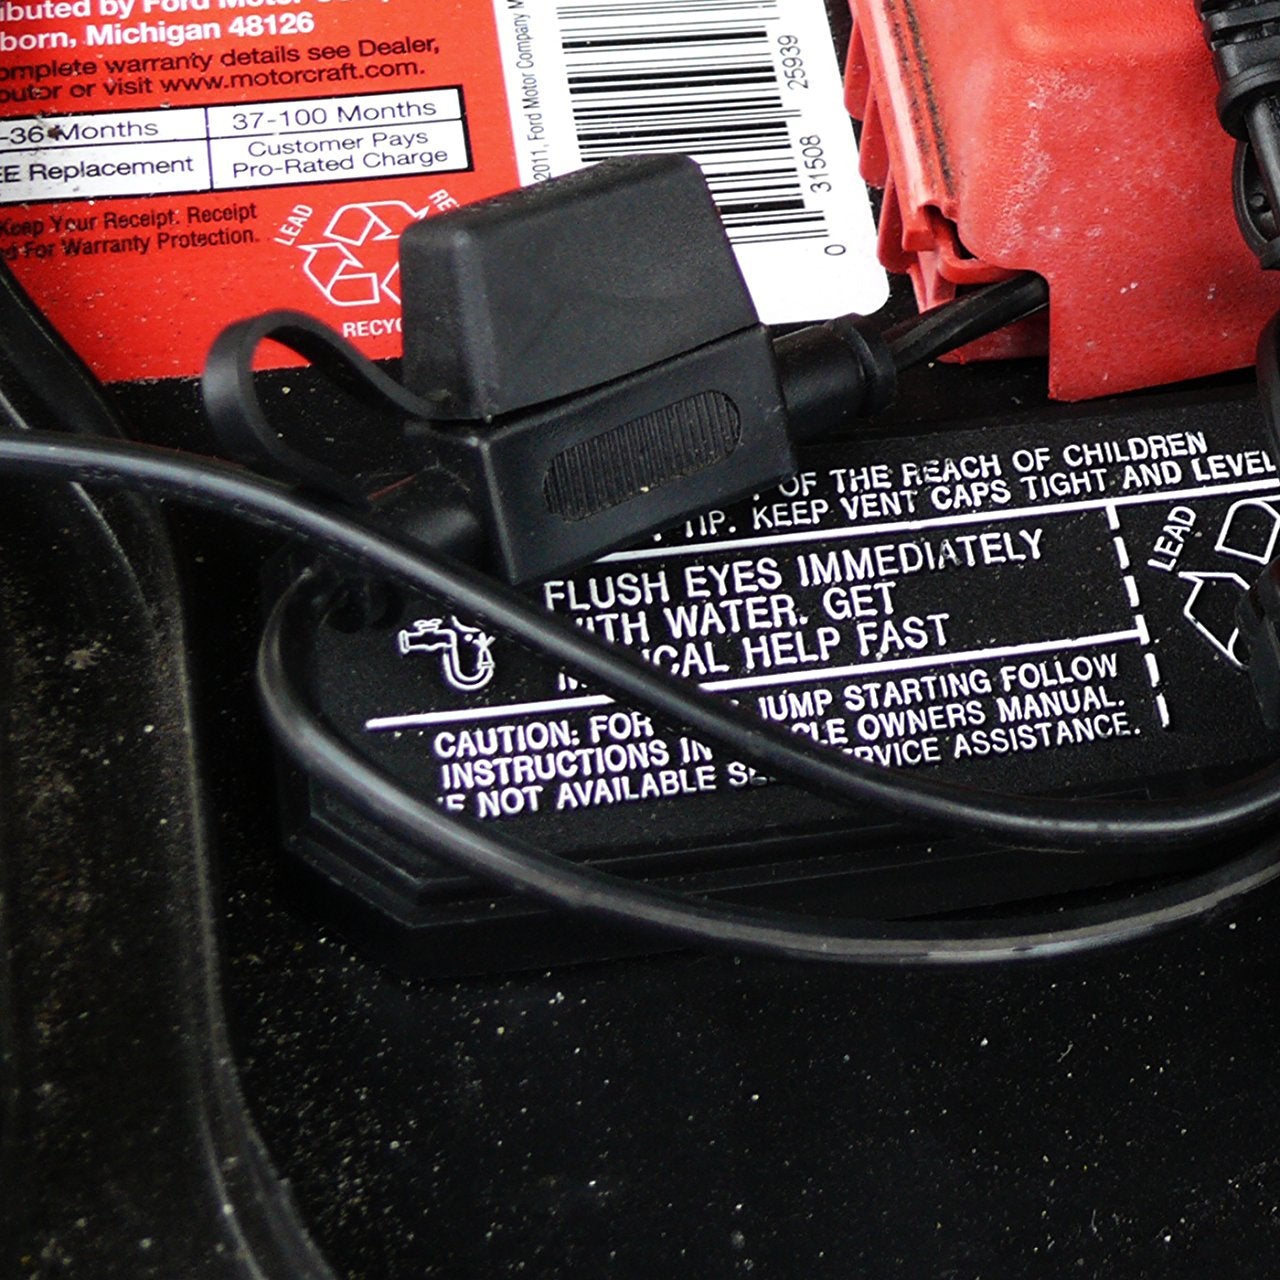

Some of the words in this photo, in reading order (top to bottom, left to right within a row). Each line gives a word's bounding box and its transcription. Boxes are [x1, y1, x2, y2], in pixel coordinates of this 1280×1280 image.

[0, 30, 77, 52] born,
[86, 20, 222, 47] Michigan
[228, 11, 315, 37] 48126
[514, 13, 534, 69] Company
[105, 52, 214, 75] warranty
[220, 46, 300, 67] details
[308, 44, 351, 61] see
[358, 37, 440, 58] Dealer,
[777, 34, 809, 90] 25939
[69, 81, 95, 99] or
[103, 76, 153, 97] visit
[160, 61, 426, 93] www.motorcraft.com.
[522, 73, 541, 109] Motor
[55, 121, 159, 141] Months
[232, 108, 327, 131] 37-100
[337, 101, 437, 123] Months
[524, 112, 545, 141] Ford
[232, 155, 354, 179] Pro-Rated
[363, 150, 448, 169] Charge
[248, 138, 363, 157] Customer
[372, 131, 428, 148] Pays
[531, 144, 551, 181] 2011,
[799, 135, 832, 193] 31508
[30, 156, 194, 182] Replacement
[51, 215, 97, 232] Your
[104, 210, 180, 229] Receipt.
[187, 203, 257, 224] Receipt
[273, 204, 313, 247] LEAD
[24, 241, 55, 258] For
[61, 236, 151, 256] Warranty
[157, 227, 260, 249] Protection.
[824, 244, 846, 256] 0
[829, 464, 892, 494] THE
[902, 455, 1002, 487] REACH
[1012, 448, 1050, 473] OF
[1063, 431, 1207, 467] CHILDREN
[753, 499, 829, 530] KEEP
[840, 490, 918, 521] VENT
[930, 479, 1011, 510] CAPS
[1020, 469, 1107, 500] TIGHT
[1122, 460, 1182, 489] AND
[1192, 450, 1277, 481] LEVEL
[1148, 506, 1196, 571] LEAD
[544, 570, 670, 611] FLUSH
[684, 557, 782, 598] EYES
[797, 528, 1042, 587] IMMEDIATELY
[663, 594, 809, 639] WATER.
[822, 581, 896, 620] GET
[742, 626, 840, 669] HELP
[857, 613, 950, 656] FAST
[844, 669, 992, 711] STARTING
[1000, 653, 1118, 691] FOLLOW
[434, 719, 580, 759] CAUTION:
[590, 711, 654, 743] FOR
[857, 700, 986, 740] OWNERS
[996, 685, 1124, 724] MANUAL.
[954, 712, 1141, 759] ASSISTANCE.
[441, 739, 670, 789] INSTRUCTIONS
[477, 785, 543, 819] NOT
[557, 765, 717, 810] AVAILABLE
